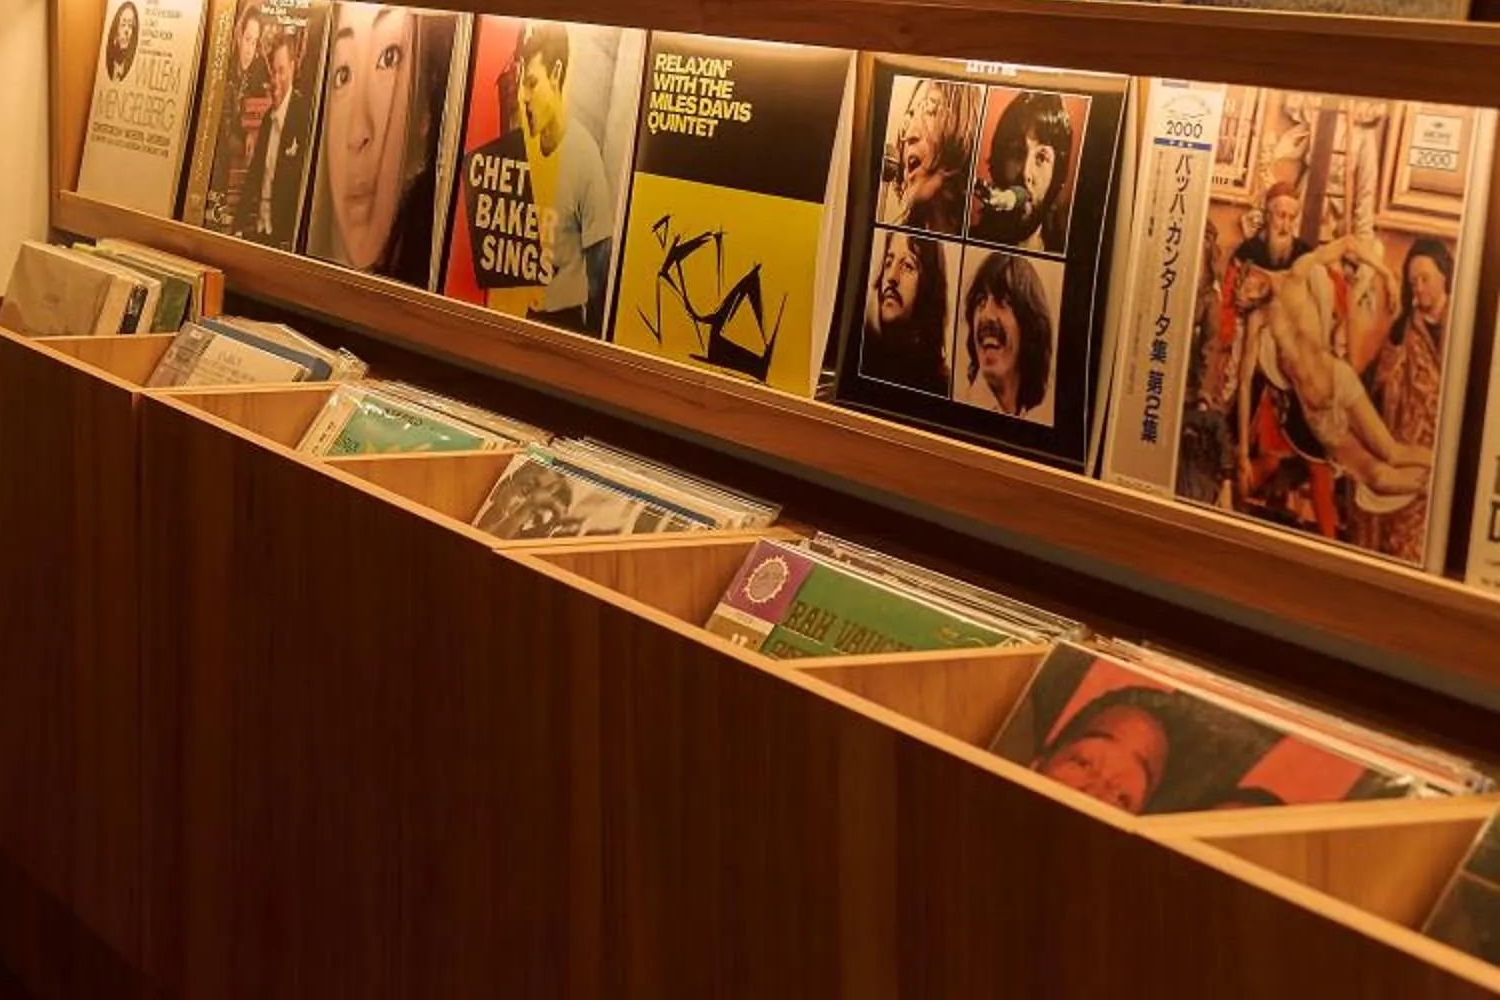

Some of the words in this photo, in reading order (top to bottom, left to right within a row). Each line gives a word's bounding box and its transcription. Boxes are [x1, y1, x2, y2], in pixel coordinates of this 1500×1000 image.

[654, 52, 733, 79] RELAXIN'
[653, 71, 699, 95] WITH
[699, 77, 735, 100] THE
[649, 90, 699, 115] MILES
[699, 96, 753, 123] DAVIS
[647, 110, 719, 138] QUINTET
[1165, 119, 1204, 139] 2000
[468, 151, 531, 197] CHET
[474, 192, 559, 246] BAKER
[479, 233, 555, 286] SINGS
